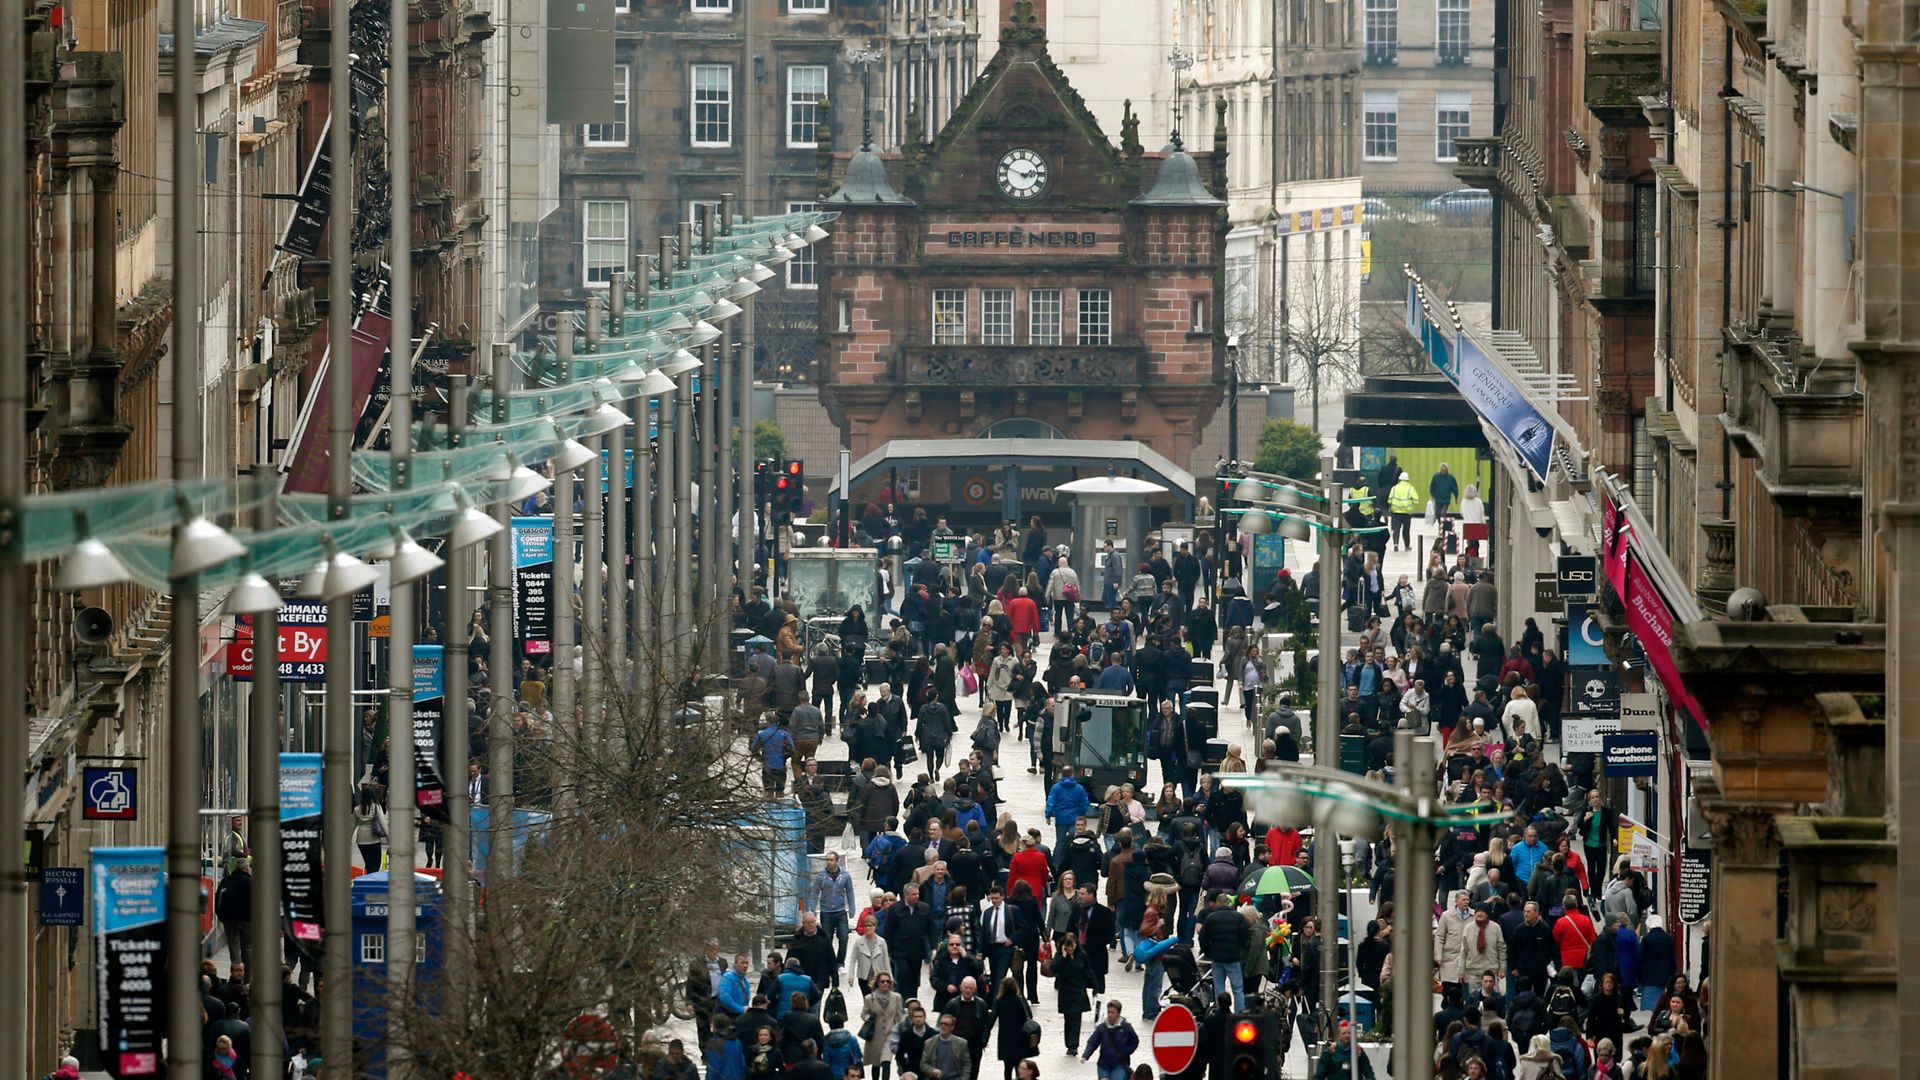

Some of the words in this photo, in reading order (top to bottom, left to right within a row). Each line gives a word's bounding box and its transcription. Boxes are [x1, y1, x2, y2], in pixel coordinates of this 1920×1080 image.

[948, 226, 1023, 248] CAFFÈ
[1028, 232, 1097, 248] NERO
[992, 483, 1058, 504] Sway
[294, 631, 322, 660] By
[297, 663, 325, 675] 4433
[1622, 708, 1656, 716] Dune
[1610, 746, 1652, 755] Carphone
[283, 840, 310, 850] 0844
[287, 852, 306, 862] 395
[110, 940, 161, 952] Tickets:
[119, 954, 152, 965] 0844
